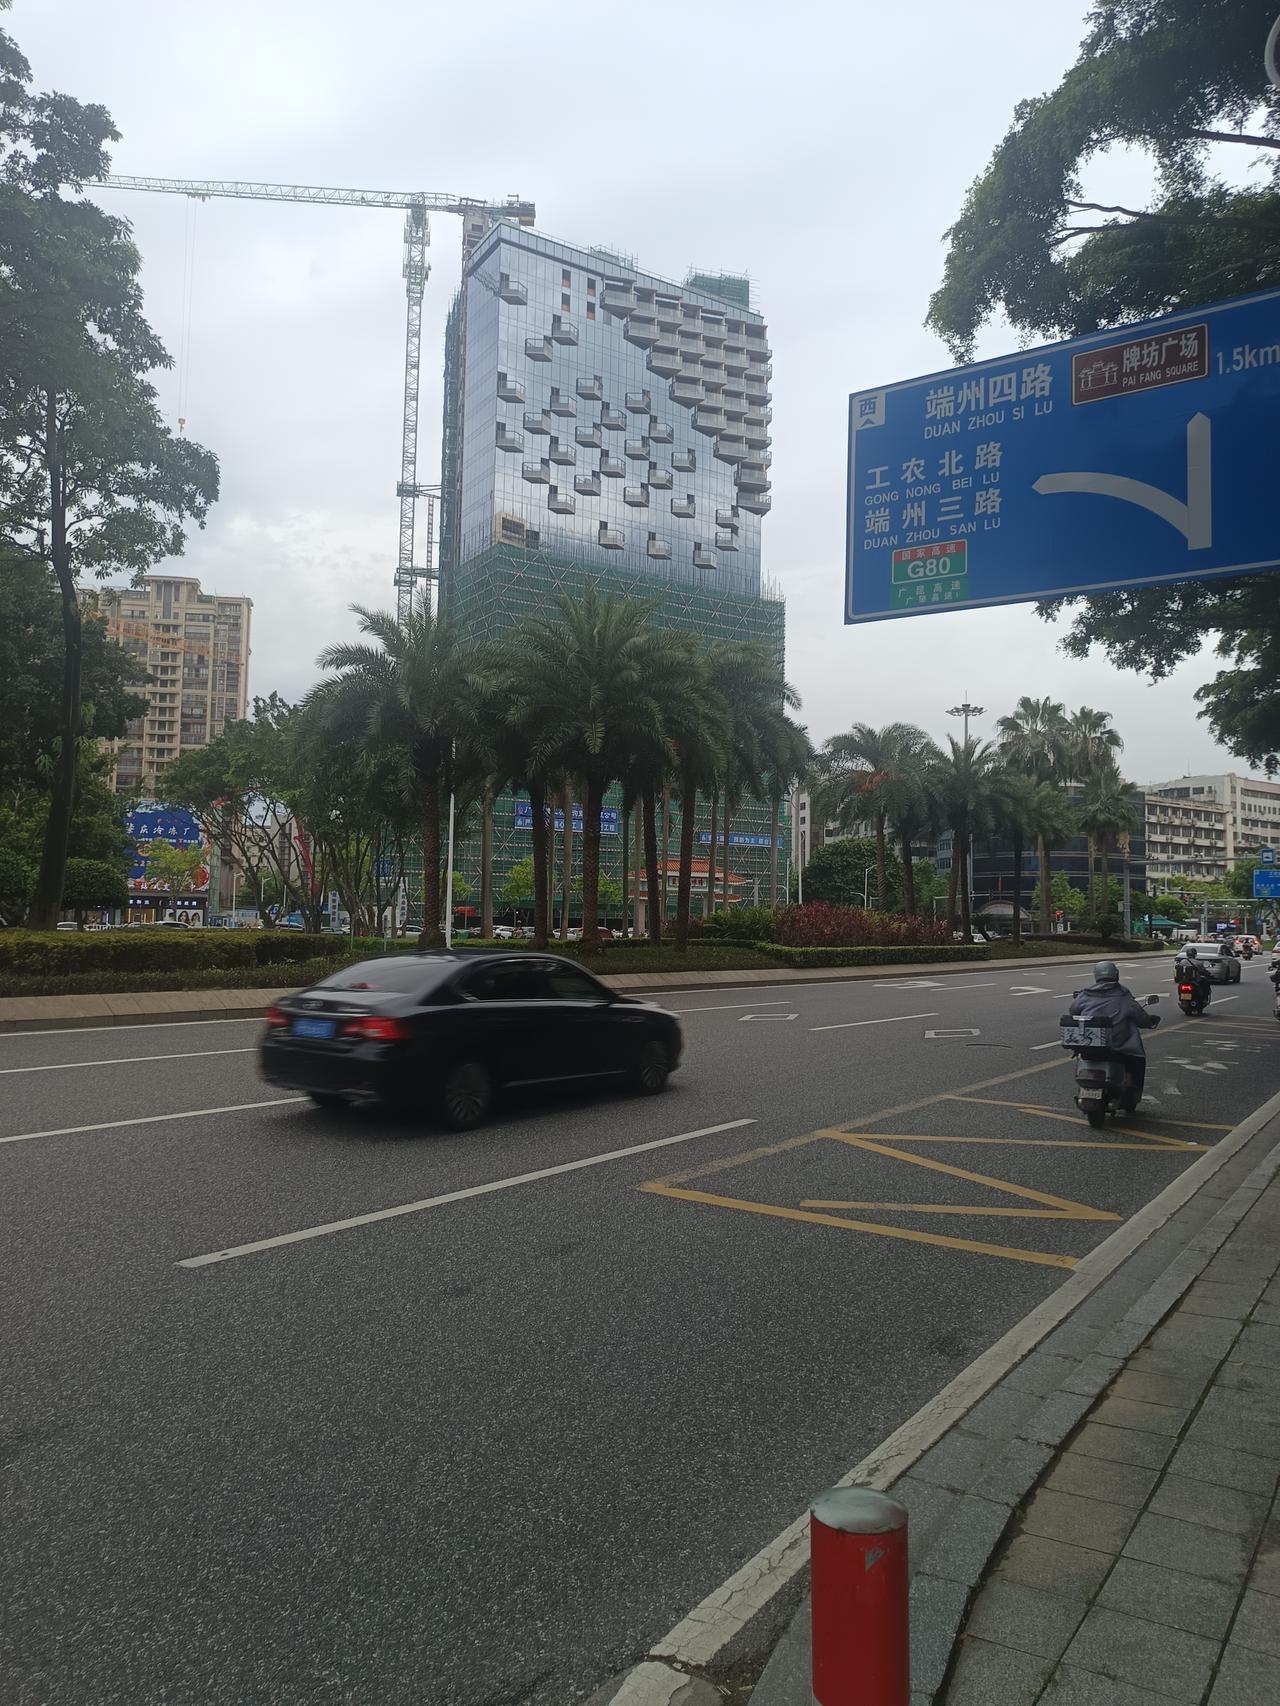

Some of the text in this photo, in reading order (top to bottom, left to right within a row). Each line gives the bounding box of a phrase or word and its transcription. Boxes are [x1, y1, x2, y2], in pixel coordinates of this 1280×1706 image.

[1122, 332, 1199, 373] 牌坊广场
[1216, 344, 1280, 375] 1.5km
[1122, 360, 1199, 387] PAI FANG SQUARE
[858, 396, 878, 418] 西
[925, 363, 1053, 420] 端州四路
[924, 400, 1053, 440] DUAN ZHOU SI LU
[865, 441, 1003, 490] 工农北路
[864, 472, 1000, 506] GONG NONG BEI LU
[865, 488, 1002, 535] 端州三路
[864, 518, 1001, 550] DUAN ZHOU SAN LU
[907, 557, 951, 578] G80
